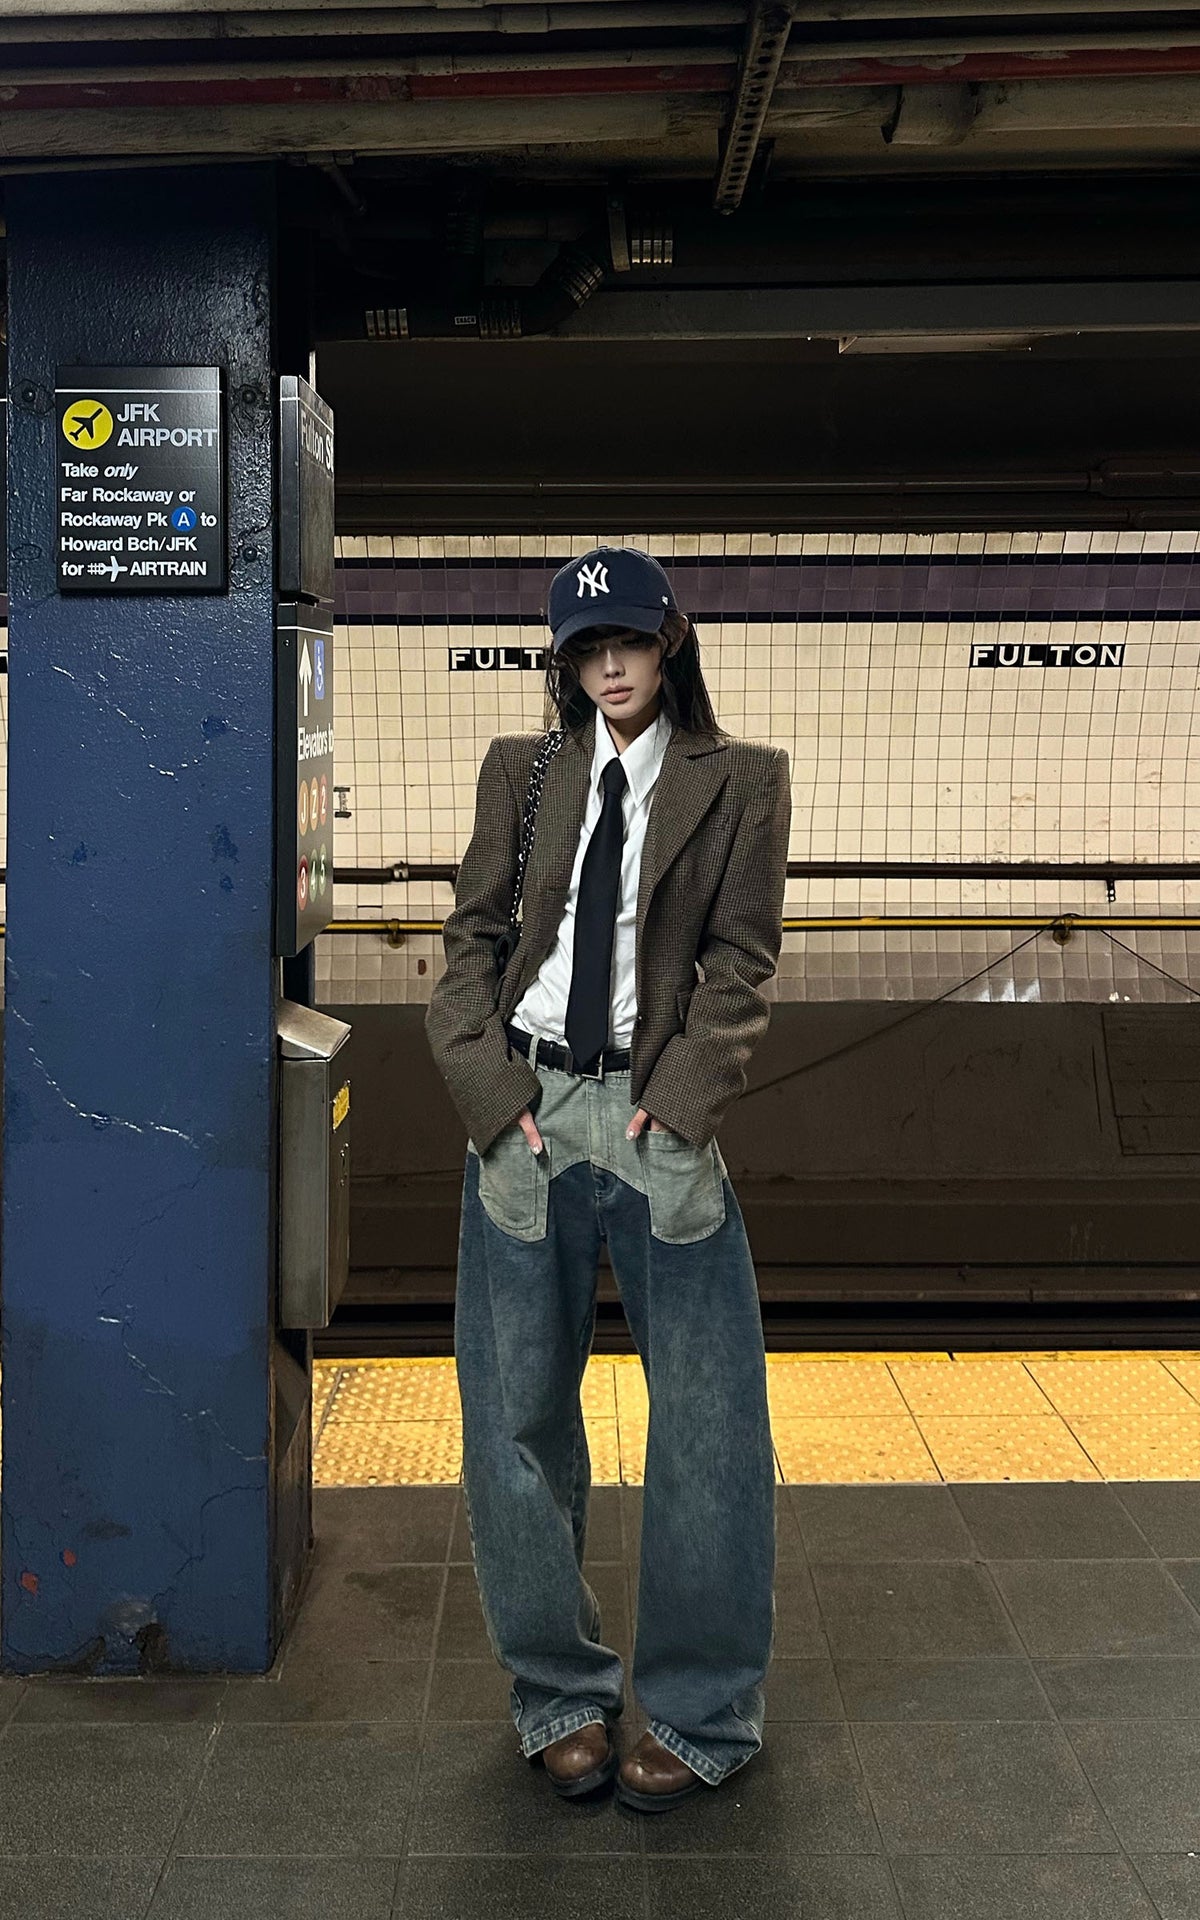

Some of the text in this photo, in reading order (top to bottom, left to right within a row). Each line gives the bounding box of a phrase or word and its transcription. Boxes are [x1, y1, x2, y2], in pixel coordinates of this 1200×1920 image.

[117, 404, 160, 422] JFK
[117, 428, 218, 447] AIRPORT
[301, 409, 324, 464] Fulton
[61, 463, 138, 481] Take only
[61, 488, 196, 505] Far Rockaway or
[61, 511, 217, 530] Rockaway Pk A to
[61, 537, 198, 552] Howard Bch/JFK
[61, 562, 207, 576] for AIRTRAIN
[576, 561, 610, 598] NY
[451, 649, 544, 669] FULT
[972, 645, 1122, 666] FULTON
[298, 725, 328, 761] Elevators
